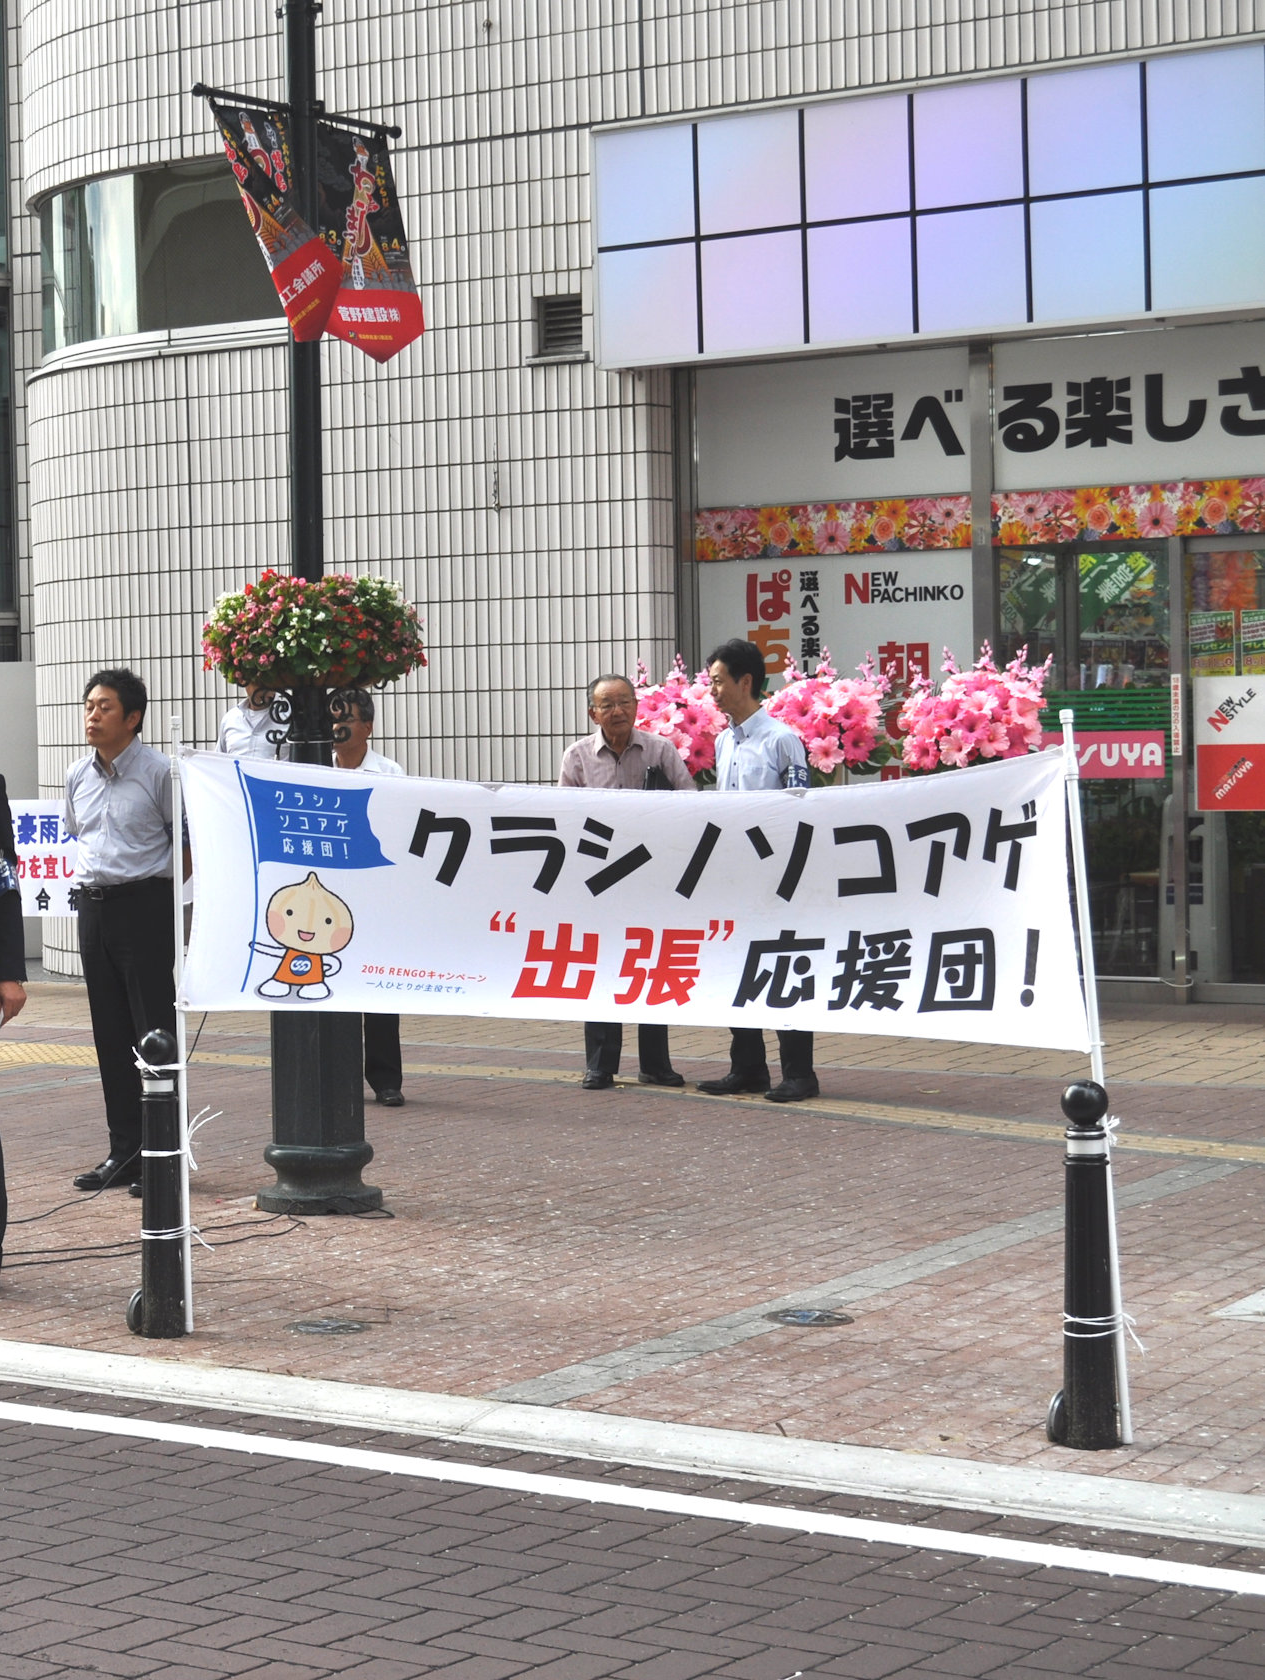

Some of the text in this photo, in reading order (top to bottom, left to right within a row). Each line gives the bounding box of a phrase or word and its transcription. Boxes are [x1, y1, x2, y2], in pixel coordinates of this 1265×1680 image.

[844, 571, 898, 604] NEW
[870, 584, 964, 604] PACHINKO
[746, 568, 792, 701] ぱち
[1207, 696, 1235, 733] NEW
[1224, 688, 1257, 721] STYLE
[1214, 760, 1254, 800] MATSUYA
[275, 790, 341, 809] クラシノ
[12, 812, 78, 845] 豪雨
[282, 837, 349, 859] 応援団!
[408, 800, 1038, 902] クラシノソコアゲ
[361, 965, 487, 983] 2016 RENGOキャンペーン
